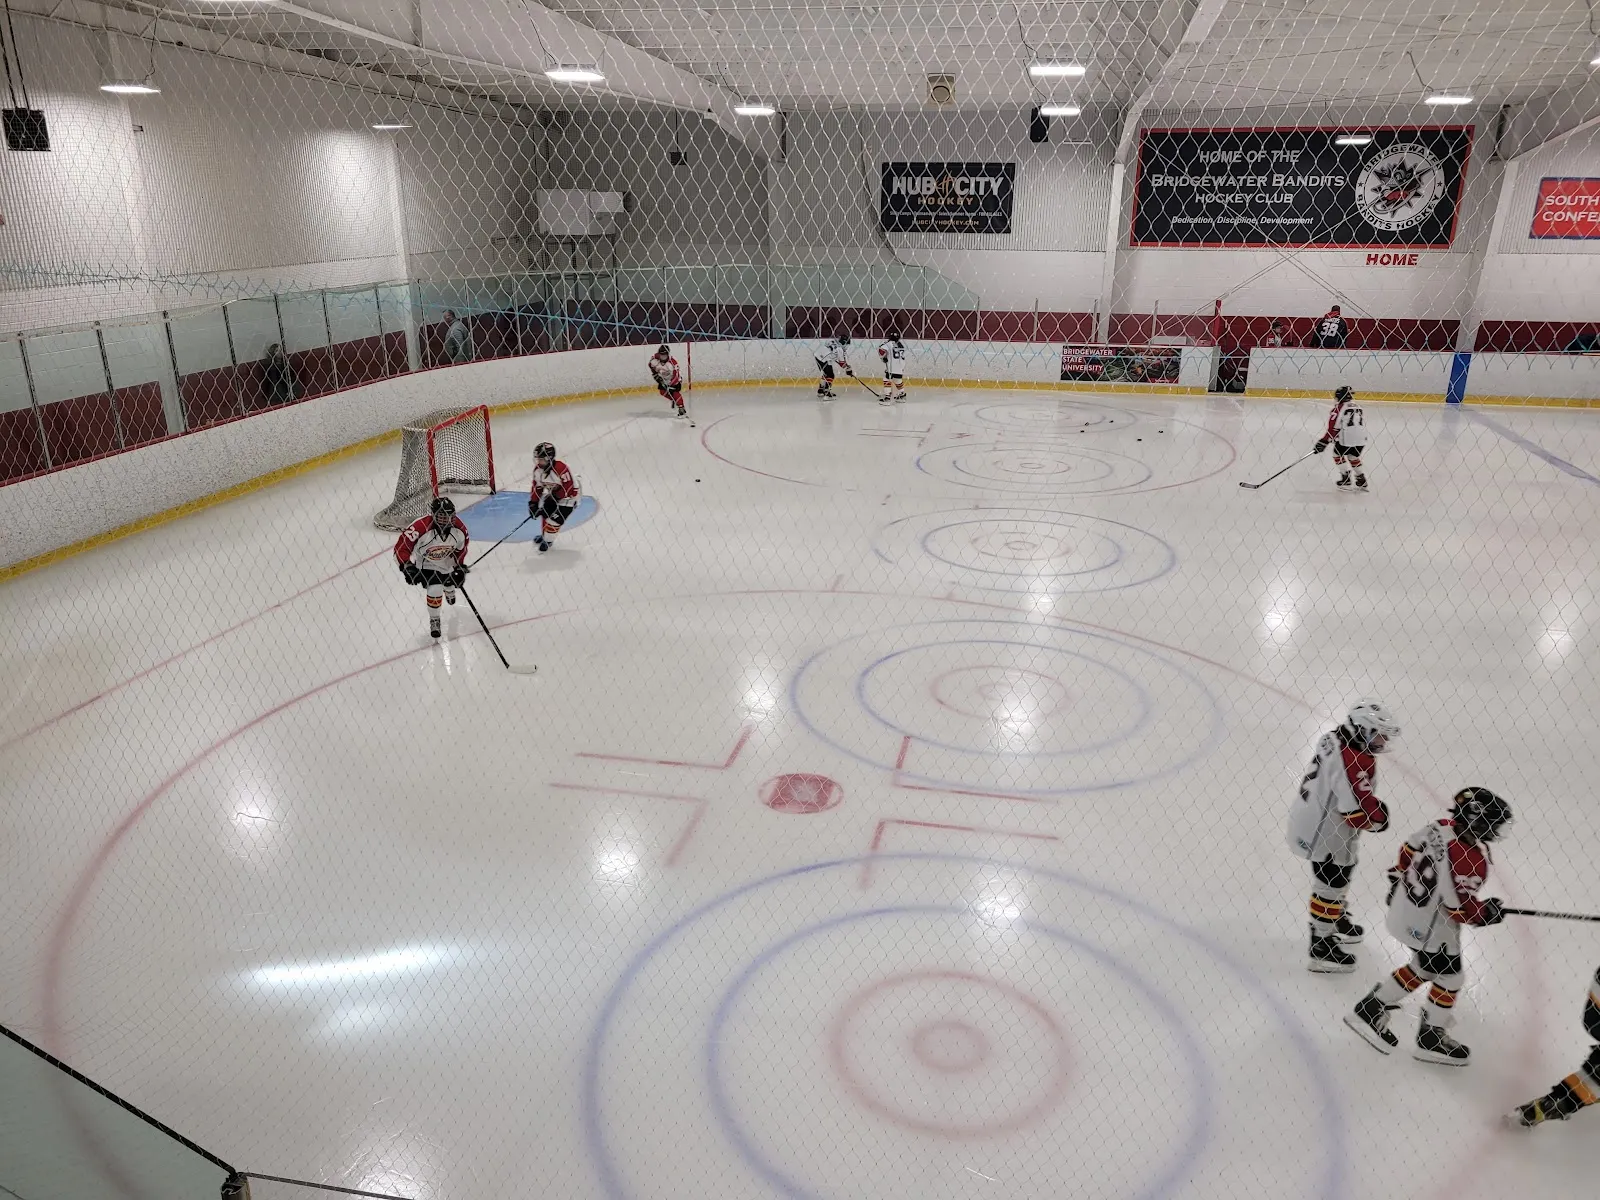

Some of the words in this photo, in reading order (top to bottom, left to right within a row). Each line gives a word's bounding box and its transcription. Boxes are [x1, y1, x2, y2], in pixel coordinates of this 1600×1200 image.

[1199, 150, 1243, 163] HOME
[1246, 150, 1267, 163] OF
[1271, 150, 1301, 163] THE
[1151, 173, 1268, 187] BRIDGEWATER
[1271, 173, 1345, 187] BANDITS
[892, 176, 936, 195] HUB
[954, 176, 1004, 196] CITY
[1195, 193, 1253, 204] HOCKEY
[1255, 193, 1294, 204] CLUB
[1545, 195, 1600, 206] SOUTH
[1260, 216, 1314, 225] Development
[1542, 211, 1600, 222] CONFE
[1366, 253, 1419, 266] HOME
[1320, 322, 1339, 338] 38
[1063, 348, 1113, 356] BRIDGEWATER
[1062, 364, 1103, 372] UNIVERSITY
